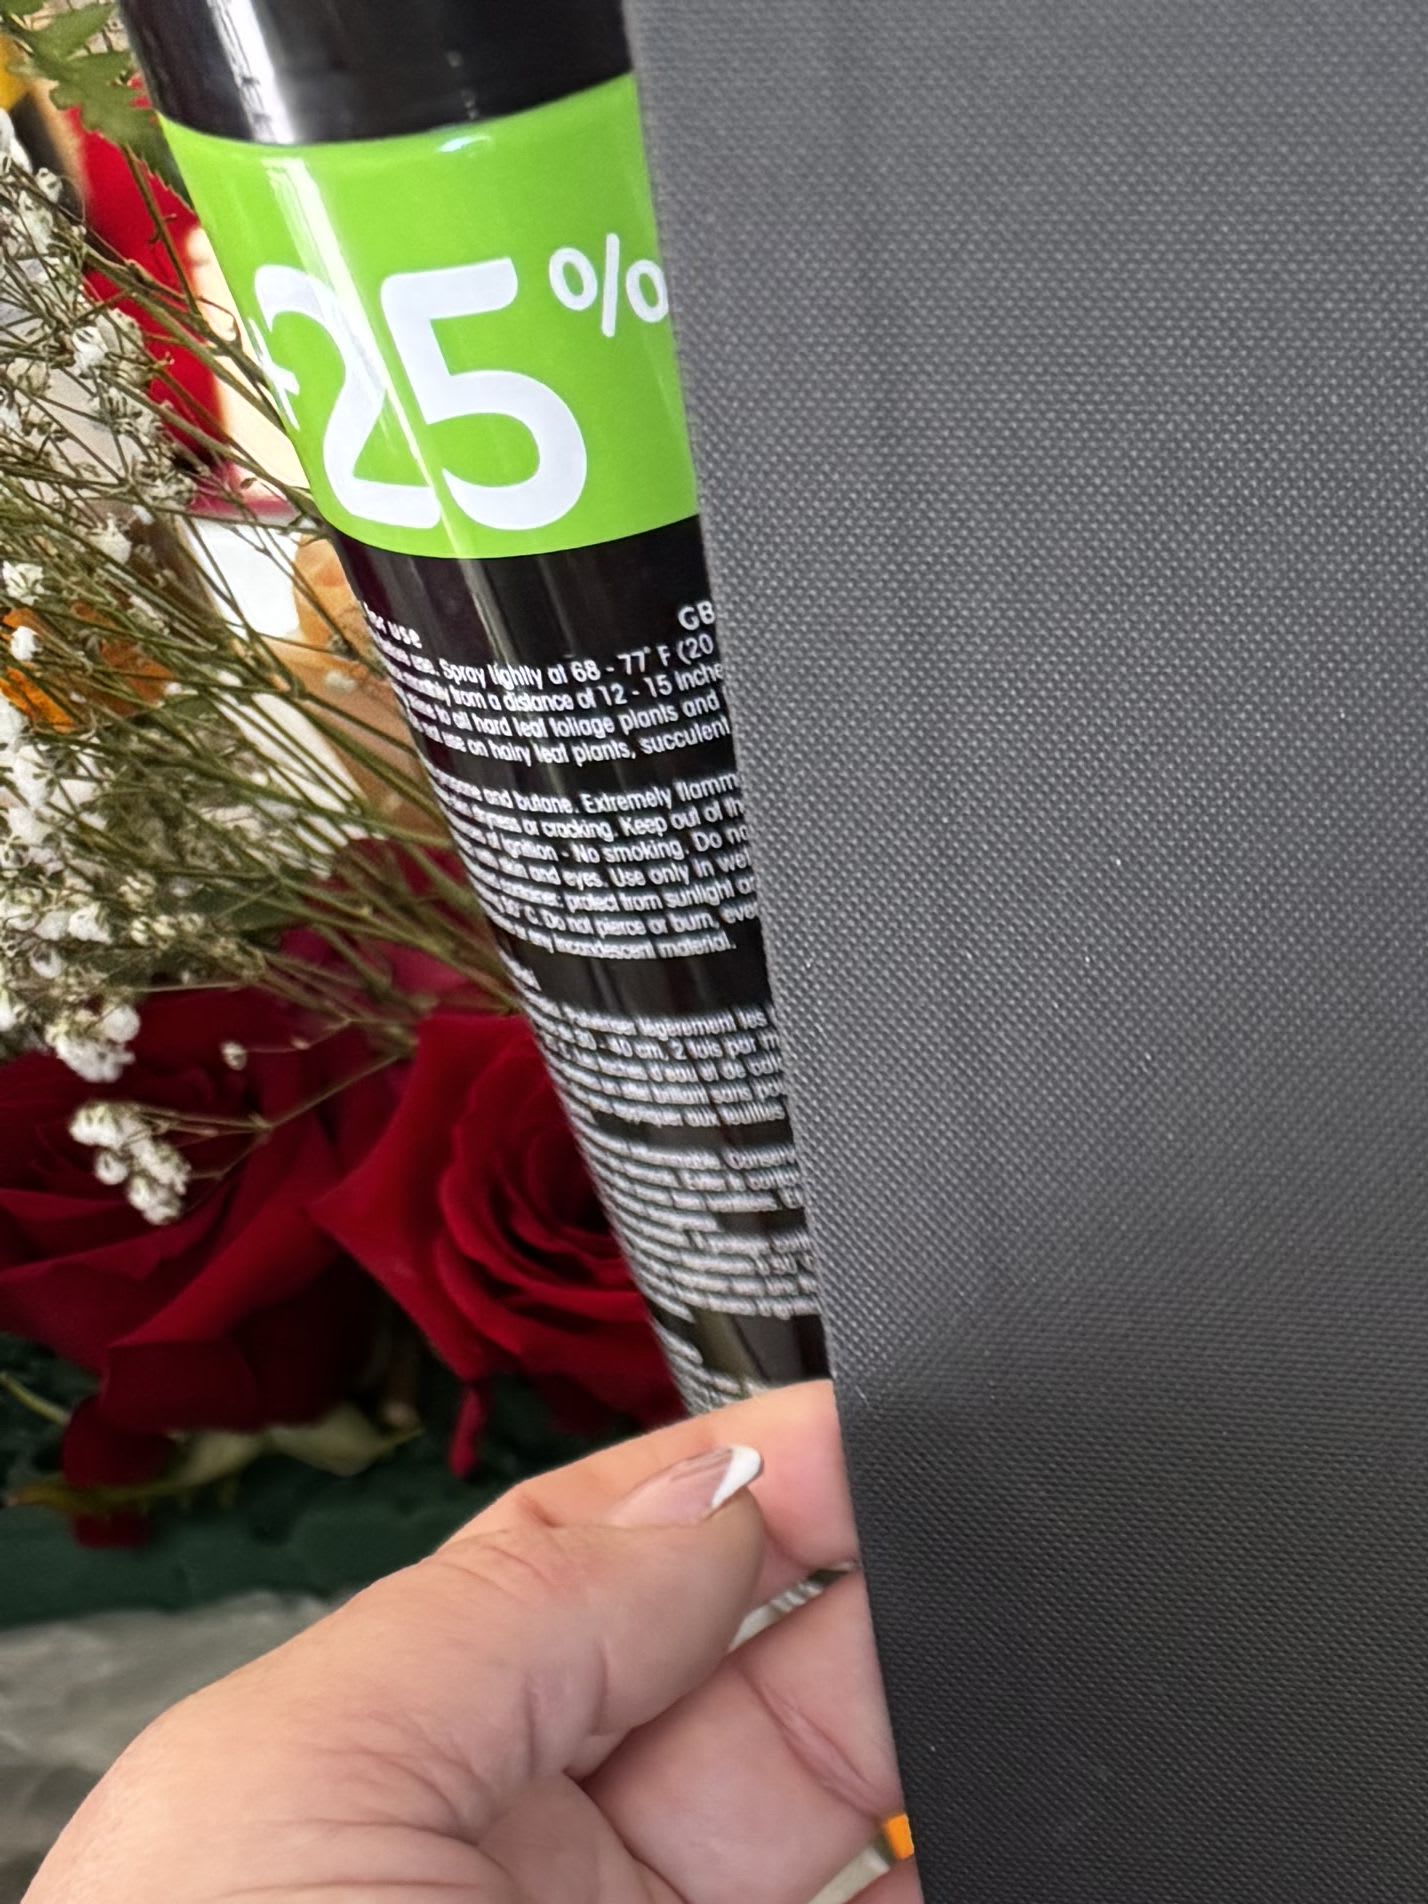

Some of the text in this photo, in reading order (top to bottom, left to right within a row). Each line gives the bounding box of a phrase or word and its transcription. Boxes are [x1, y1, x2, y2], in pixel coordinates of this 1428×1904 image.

[678, 600, 715, 630] GB
[438, 658, 486, 689] Spray
[487, 661, 543, 690] lightly
[548, 664, 568, 685] at
[570, 660, 601, 682] 68
[656, 646, 671, 667] F
[449, 685, 487, 709] from
[488, 692, 501, 711] a
[502, 691, 574, 712] distance
[577, 687, 597, 709] of
[597, 682, 627, 706] 12
[644, 674, 672, 698] 15
[472, 712, 513, 737] hard
[512, 716, 549, 738] leaf
[549, 716, 615, 739] foliage
[618, 703, 679, 735] plants
[682, 688, 721, 717] and
[488, 740, 532, 767] hairy
[531, 742, 570, 764] leaf
[571, 739, 636, 767] plants,
[511, 789, 579, 813] butane.
[580, 786, 672, 814] Extremely
[540, 818, 618, 842] cracking.
[618, 814, 668, 837] Keep
[669, 806, 701, 830] out
[703, 800, 723, 823] of
[571, 843, 600, 863] No
[603, 838, 690, 862] smoking.
[691, 831, 722, 851] Do
[609, 866, 647, 888] Use
[648, 861, 690, 886] only
[618, 890, 664, 912] from
[662, 878, 735, 908] sunlight
